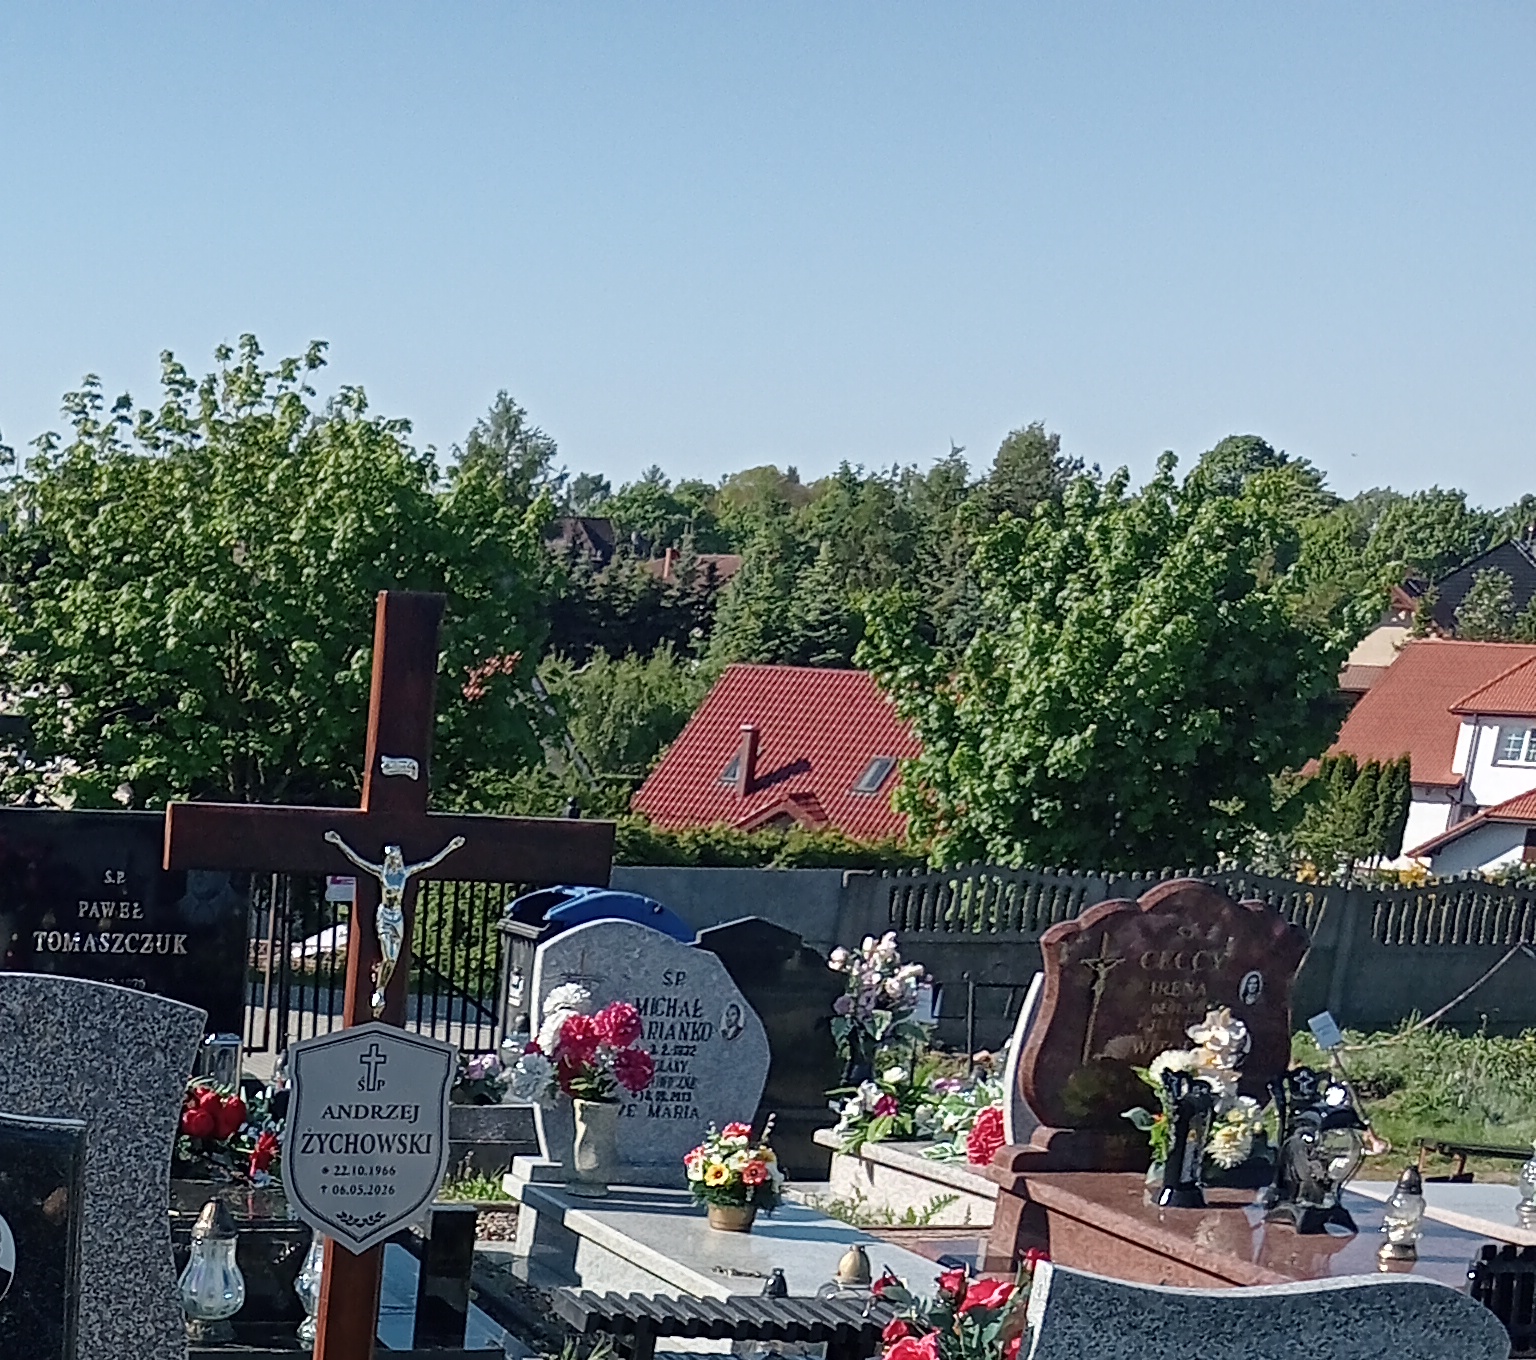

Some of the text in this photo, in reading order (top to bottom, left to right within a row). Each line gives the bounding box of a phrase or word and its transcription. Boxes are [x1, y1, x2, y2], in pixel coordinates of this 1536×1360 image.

[78, 900, 145, 919] PAWEŁ
[32, 930, 189, 955] TOMASZCZUK
[635, 997, 704, 1018] MICHAŁ
[320, 1104, 421, 1125] ANDRZEJ
[648, 1103, 701, 1119] MARIA
[300, 1127, 433, 1155] ŻYCHOWSKI
